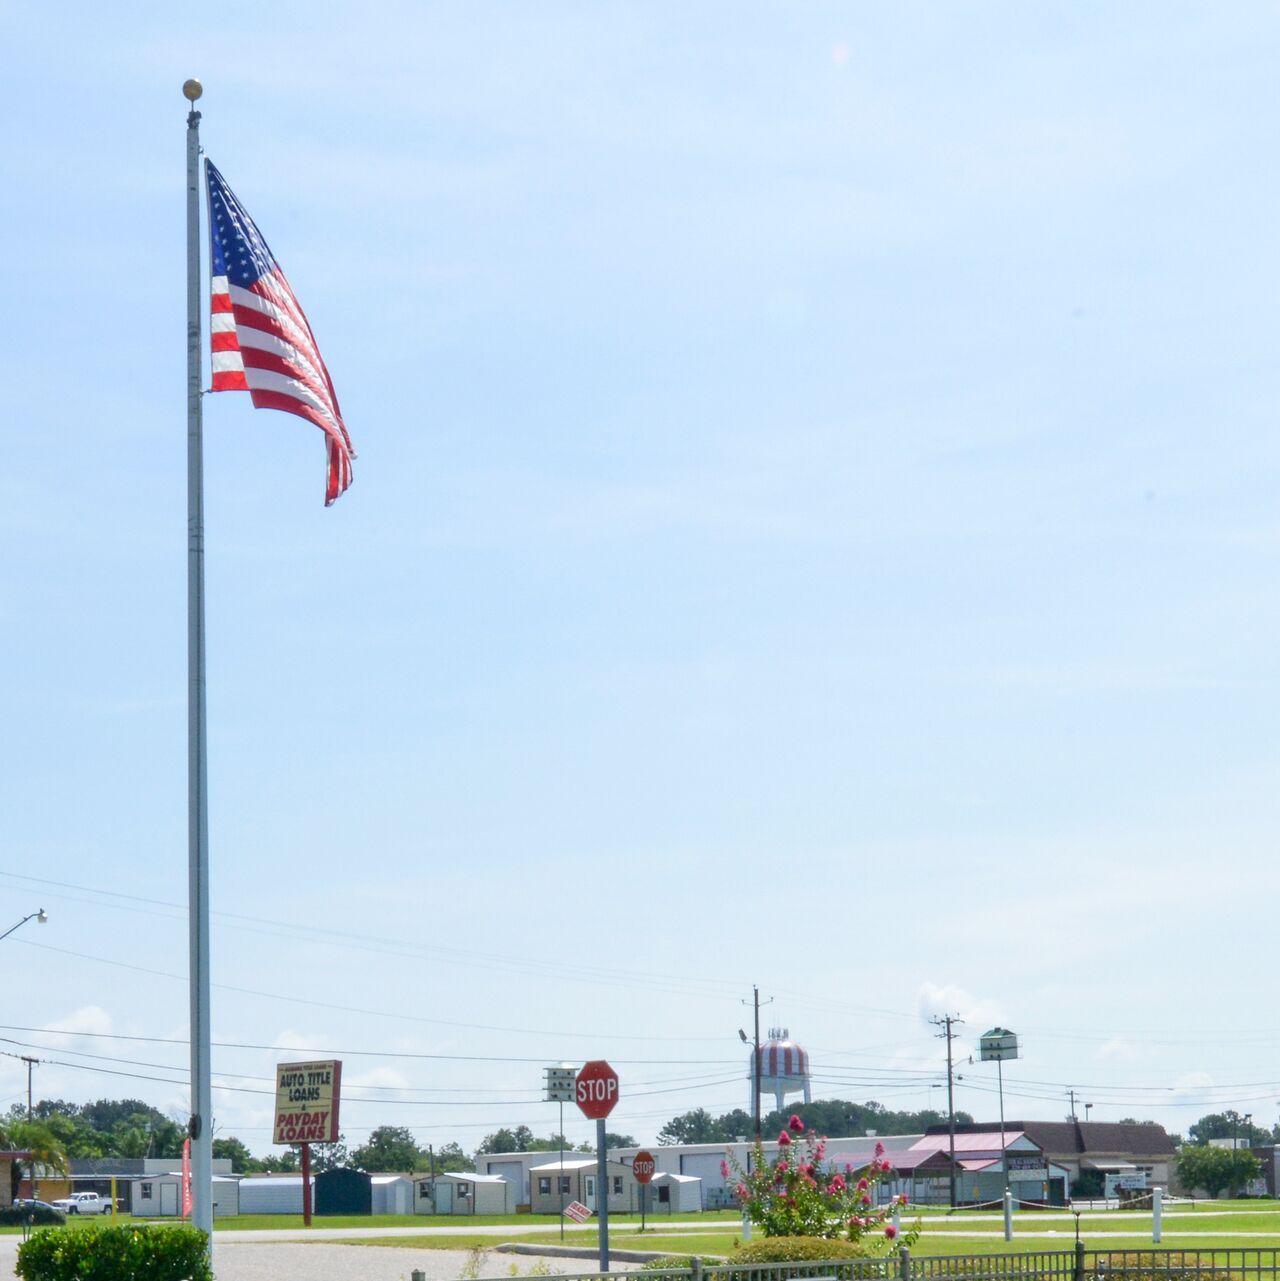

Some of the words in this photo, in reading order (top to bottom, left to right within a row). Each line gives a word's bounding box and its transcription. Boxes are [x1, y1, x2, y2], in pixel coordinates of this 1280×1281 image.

[280, 1073, 305, 1088] AUTO
[308, 1071, 331, 1086] TITLE
[289, 1087, 320, 1102] LOANS
[577, 1078, 617, 1102] STOP
[277, 1111, 330, 1128] PAYDAY
[278, 1126, 326, 1142] LOANS
[634, 1160, 654, 1175] STOP
